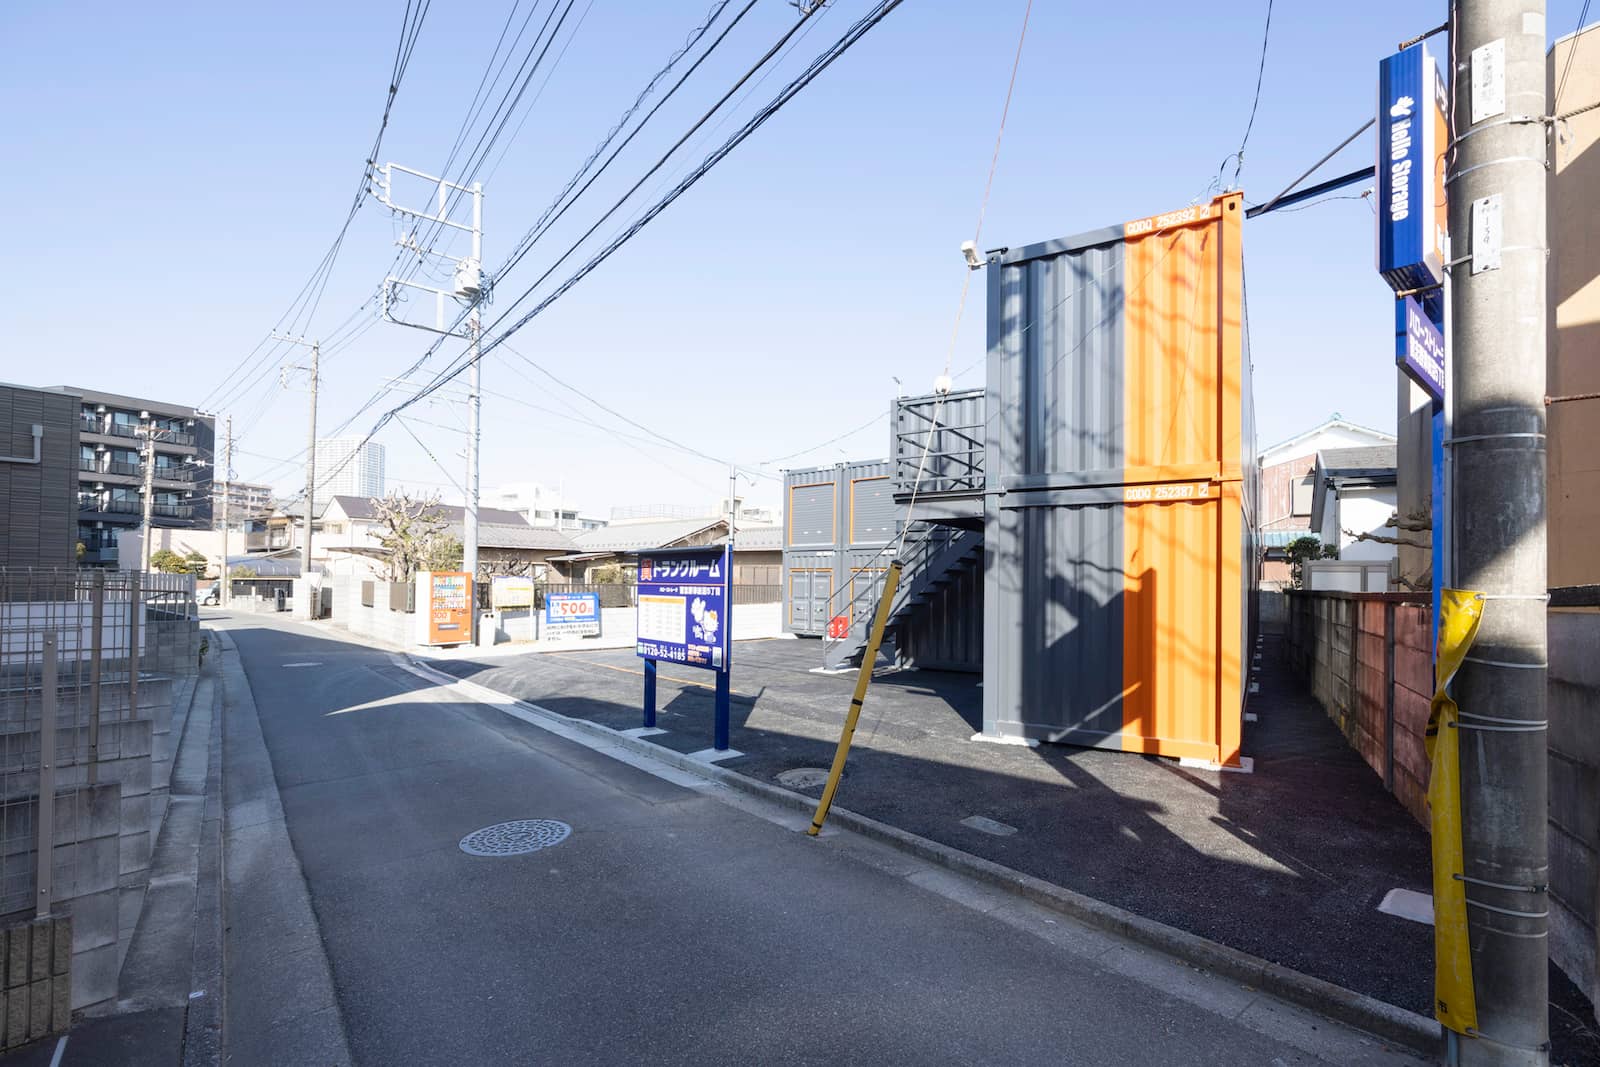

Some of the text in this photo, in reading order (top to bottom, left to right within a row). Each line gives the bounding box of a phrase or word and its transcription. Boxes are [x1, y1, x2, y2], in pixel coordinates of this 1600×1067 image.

[1391, 117, 1412, 222] Hello Storage
[1154, 485, 1194, 498] 252387
[644, 647, 686, 661] 0120-52-4185
